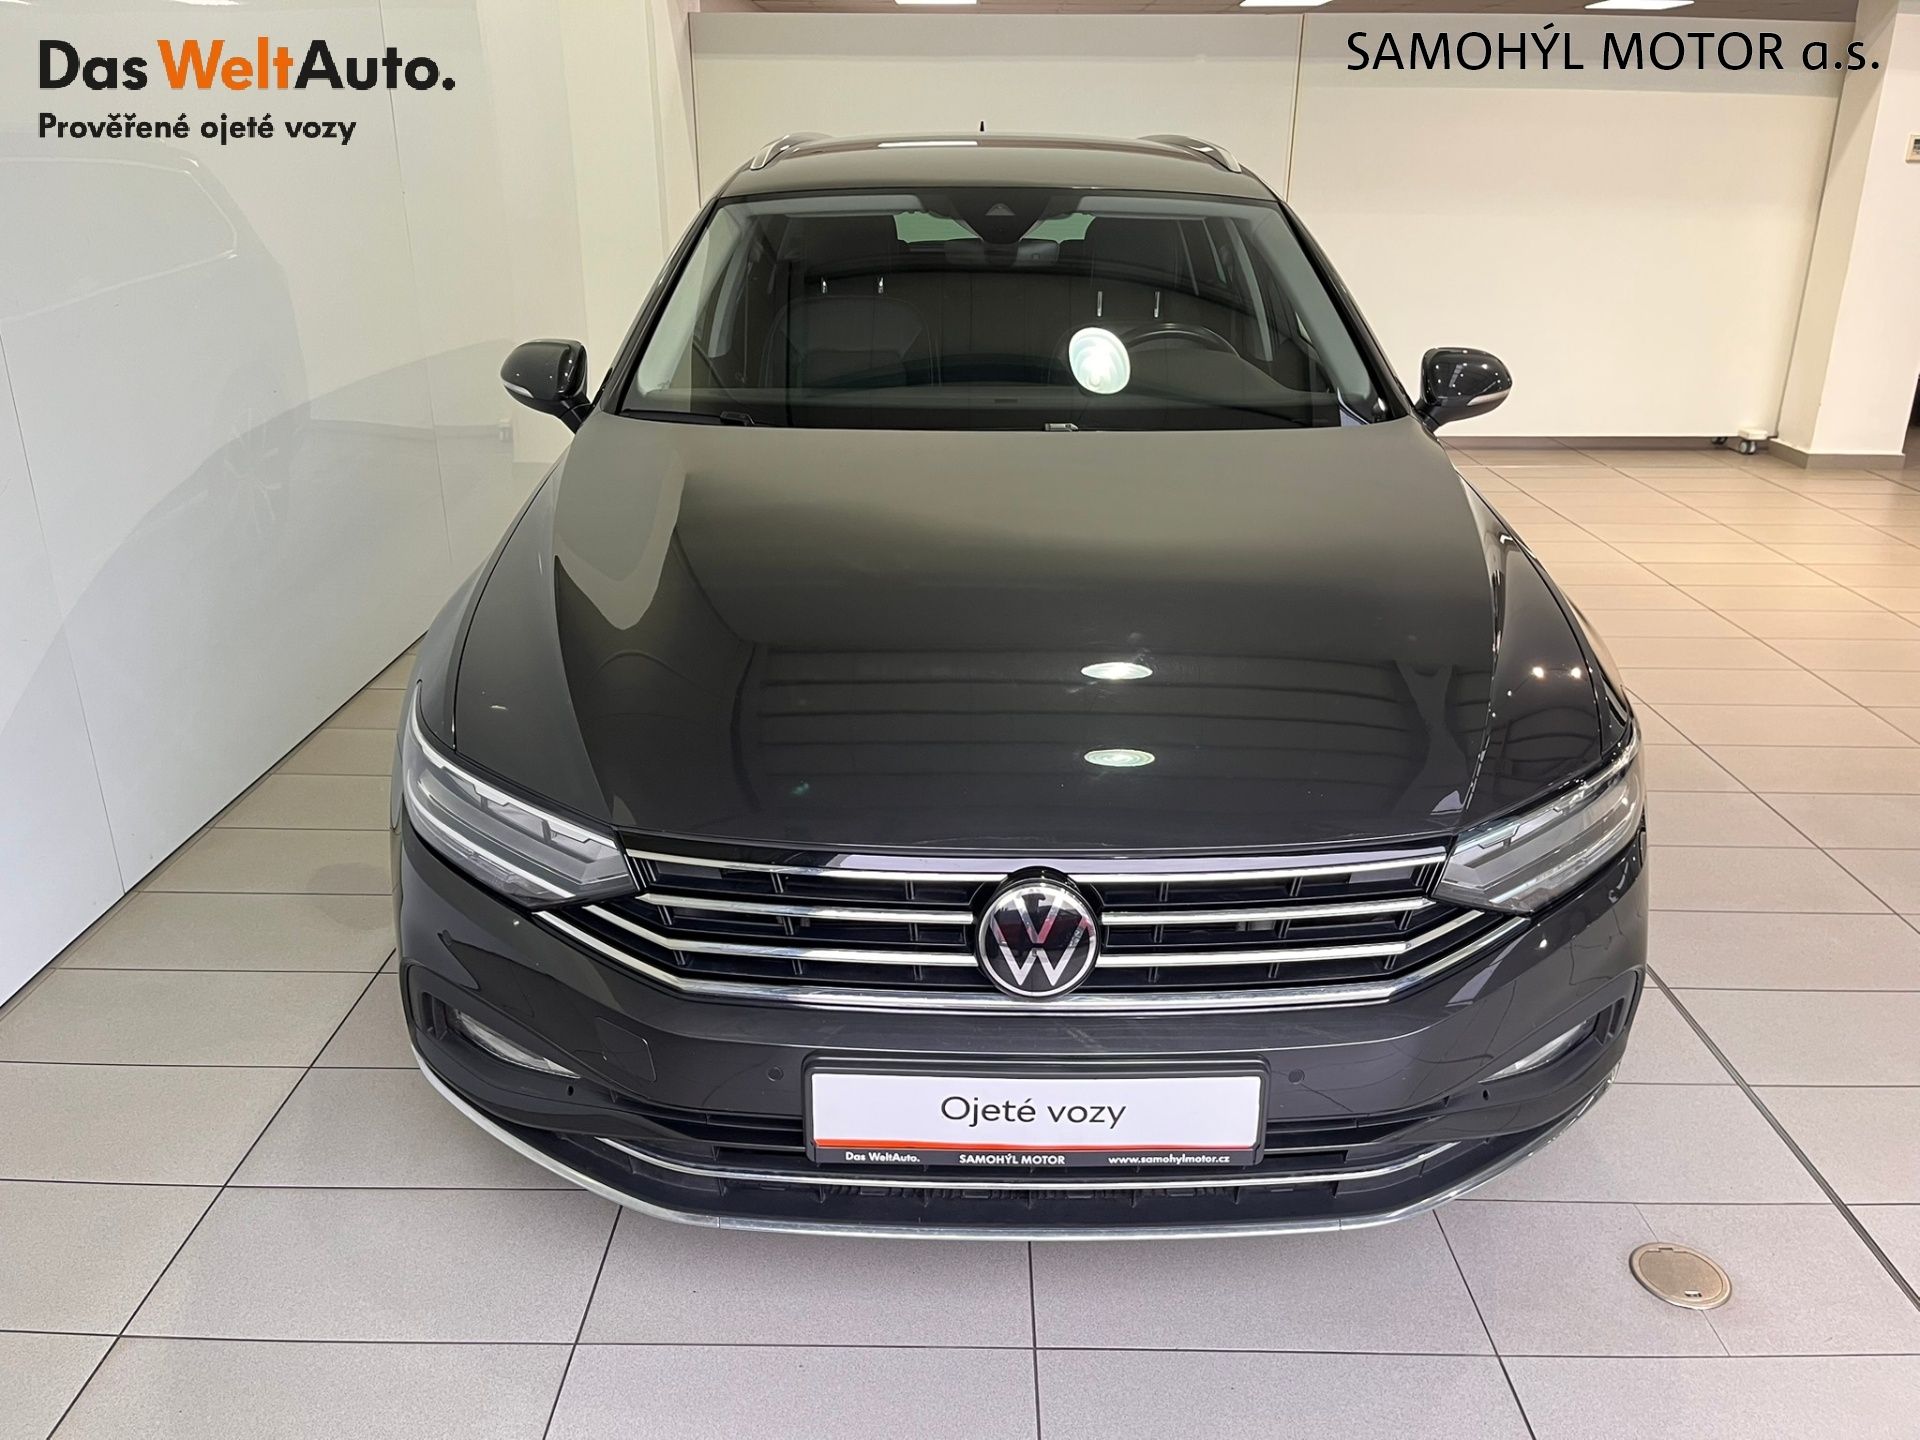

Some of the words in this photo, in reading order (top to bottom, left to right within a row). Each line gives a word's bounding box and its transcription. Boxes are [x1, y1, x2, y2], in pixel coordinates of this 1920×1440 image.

[940, 1096, 1036, 1127] Ojeté
[1048, 1104, 1127, 1129] vozy
[845, 1151, 866, 1161] Das
[868, 1151, 920, 1163] WeltAuto.
[959, 1152, 1018, 1164] SAMOHÝL
[1021, 1154, 1065, 1165] MOTOR
[1108, 1153, 1230, 1165] www.samohylmotor.cz
